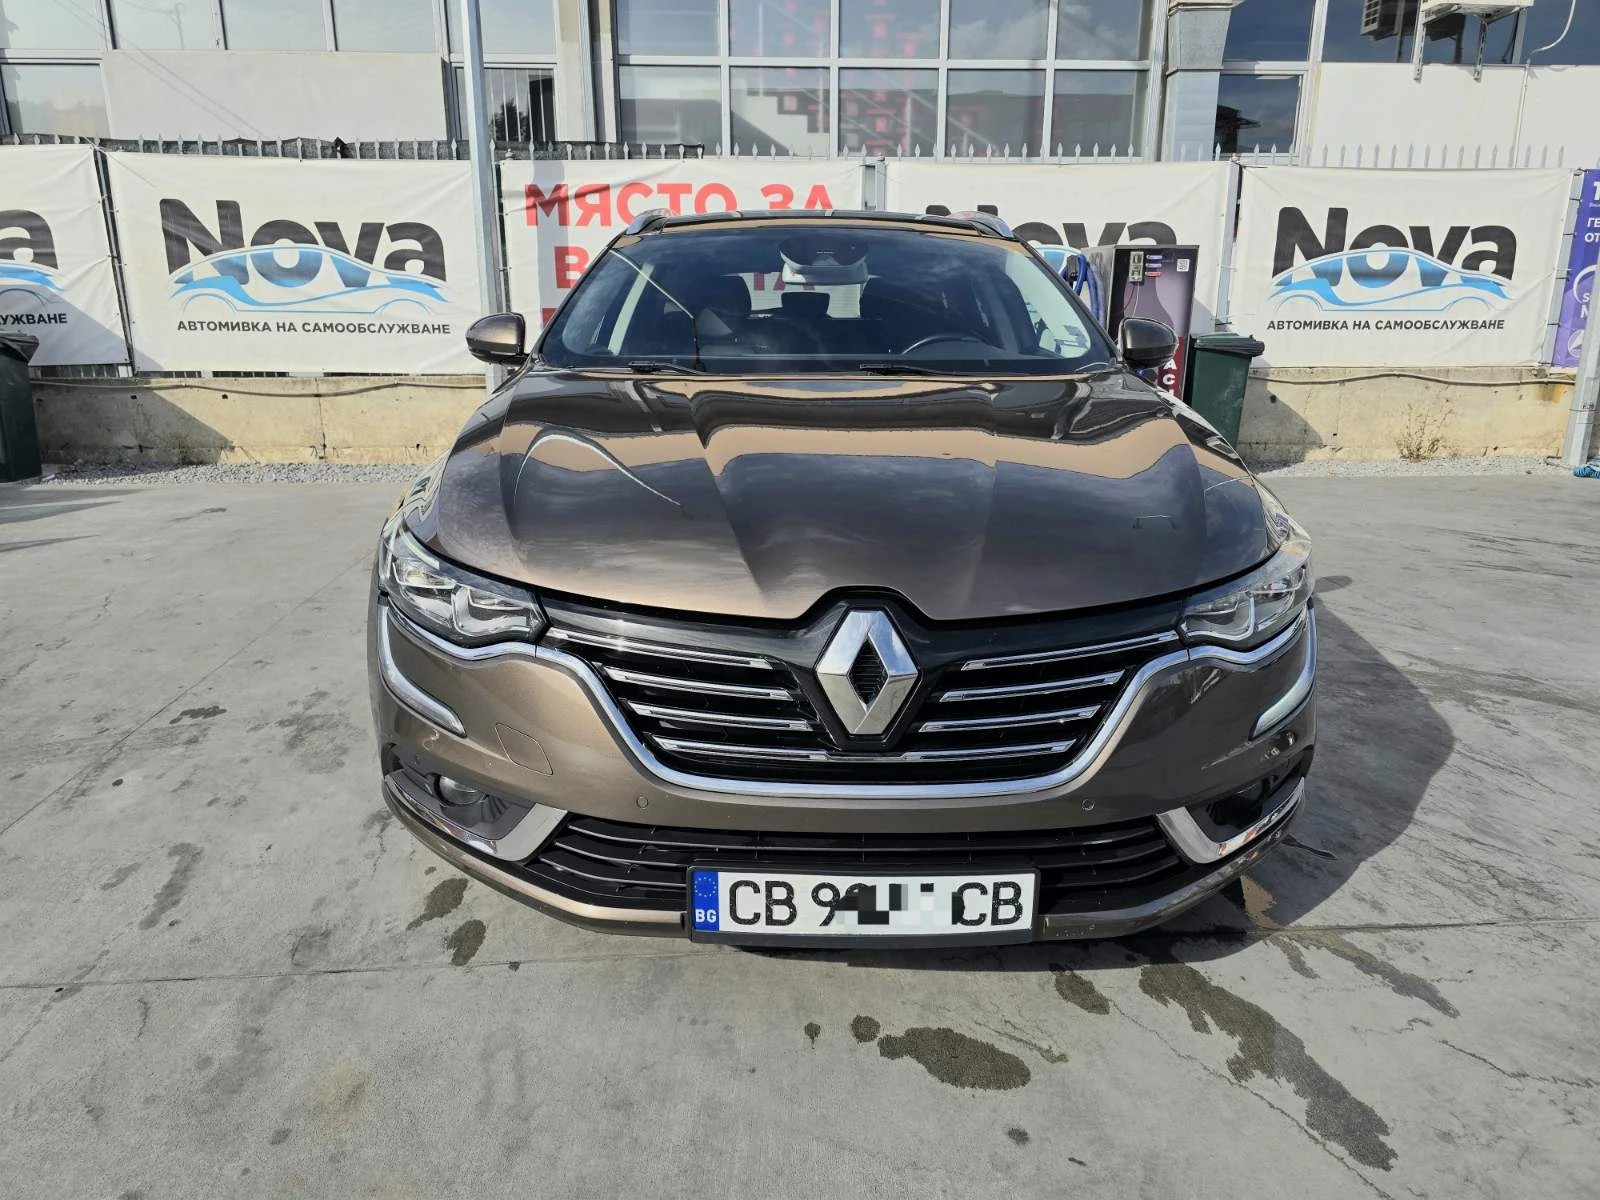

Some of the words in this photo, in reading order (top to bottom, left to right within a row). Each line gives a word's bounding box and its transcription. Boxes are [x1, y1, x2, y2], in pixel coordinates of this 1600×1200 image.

[524, 182, 738, 227] МЯСТО
[160, 198, 447, 288] Nova
[1272, 207, 1517, 288] Nova
[0, 313, 68, 326] УЖВАНЕ
[177, 318, 272, 334] АВТОМИВКА
[277, 321, 298, 334] НА
[302, 321, 451, 336] САМООБСЛУЖВАНЕ
[1267, 319, 1349, 331] АВТОМИВКА
[1352, 319, 1372, 331] НА
[1375, 319, 1505, 331] САМООБСЛУЖВАНЕ
[695, 909, 717, 923] BG
[728, 880, 798, 927] CB
